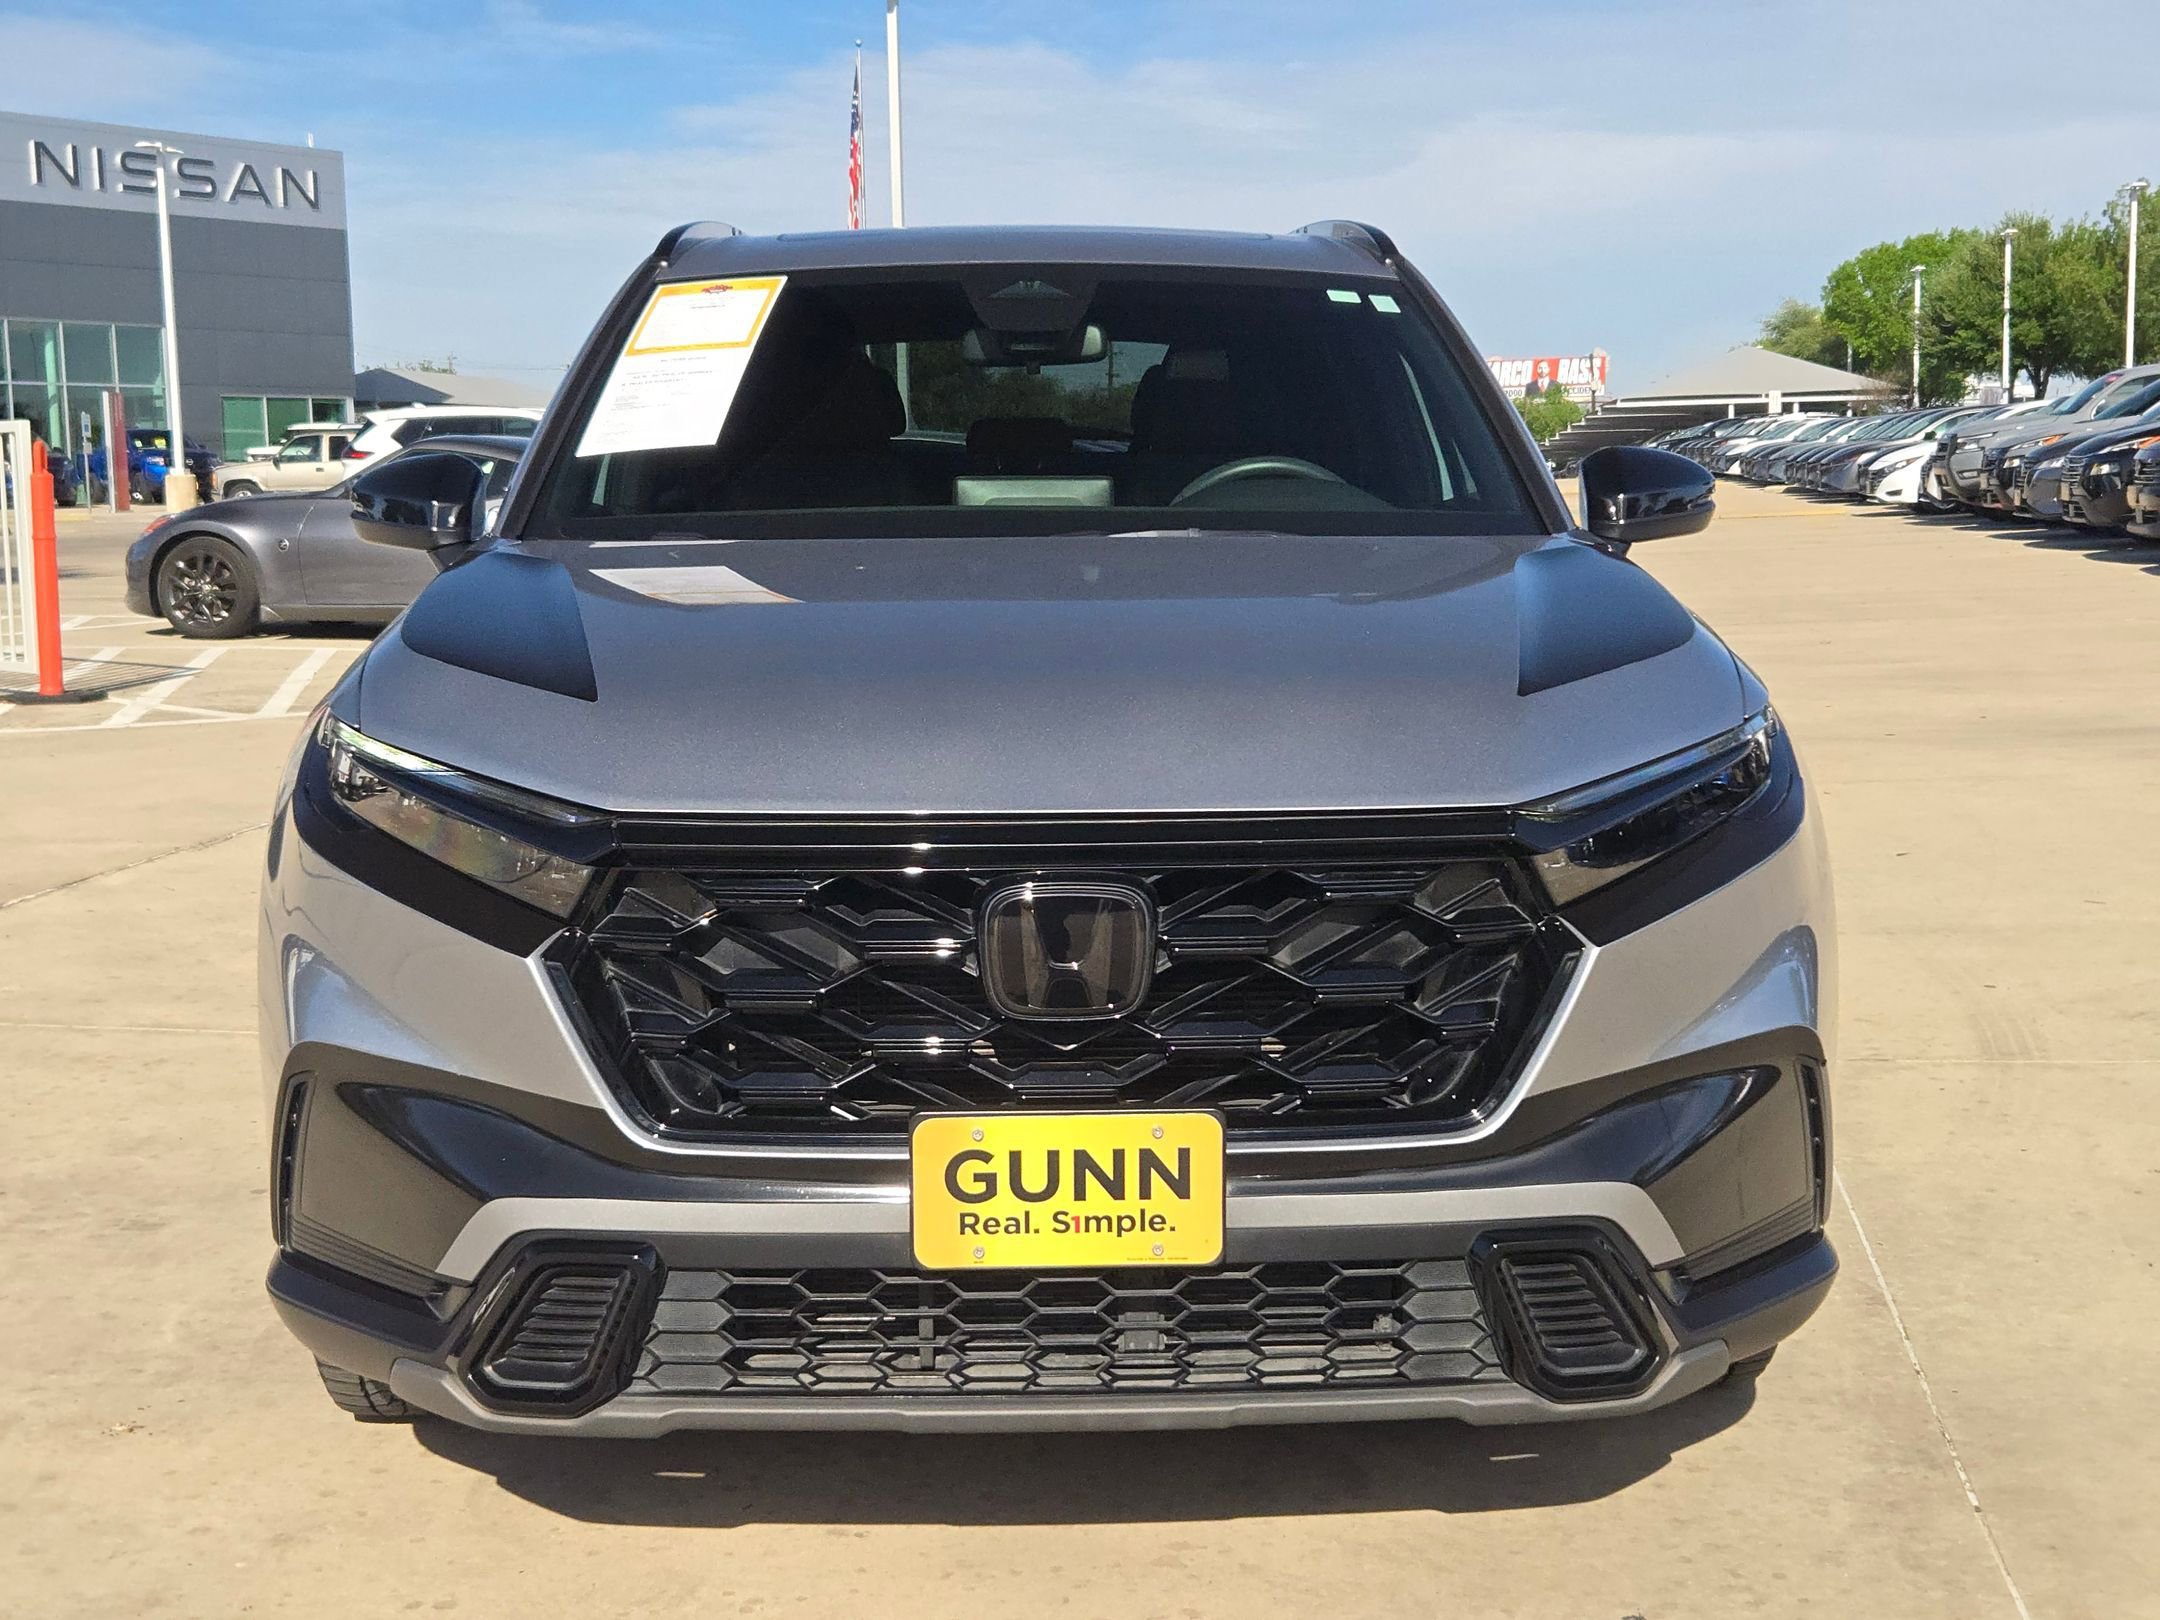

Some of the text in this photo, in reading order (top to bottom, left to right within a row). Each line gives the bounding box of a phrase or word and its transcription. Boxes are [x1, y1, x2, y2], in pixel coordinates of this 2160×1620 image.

[29, 139, 320, 210] NISSAN
[1488, 357, 1601, 387] ARCO BASS
[944, 1147, 1191, 1204] GUNN
[959, 1210, 1040, 1236] Real.
